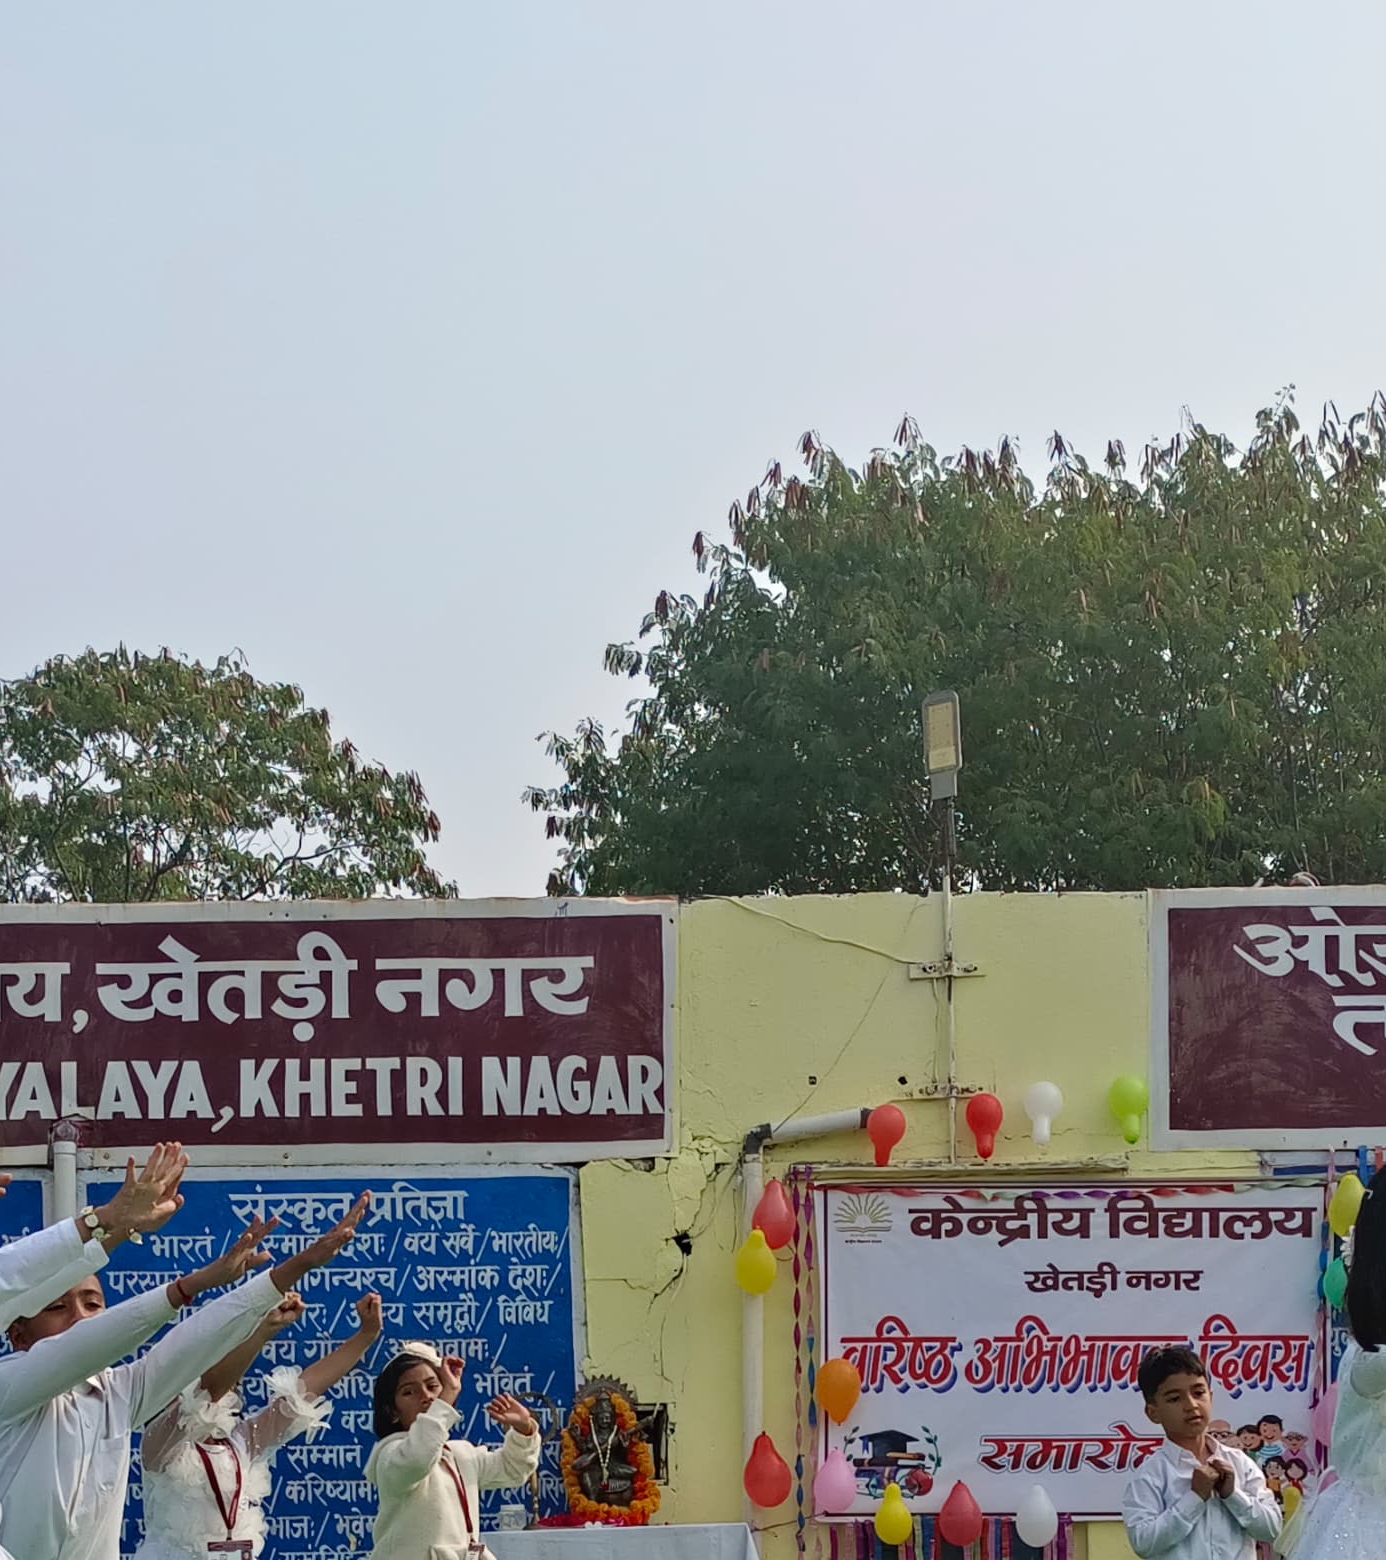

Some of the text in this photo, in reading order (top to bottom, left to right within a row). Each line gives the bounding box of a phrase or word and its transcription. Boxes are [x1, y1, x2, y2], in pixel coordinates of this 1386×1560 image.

[95, 930, 359, 1042] खेतड़ी
[375, 956, 595, 1017] नगर
[240, 1056, 463, 1118] KHETRI
[481, 1054, 665, 1116] NAGAR
[908, 1193, 1318, 1248] केन्द्रीय विद्यालय
[1025, 1262, 1204, 1298] खेतड़ी नगर
[840, 1315, 964, 1395] वरिष्ठ
[965, 1315, 1195, 1395] अभिभाव
